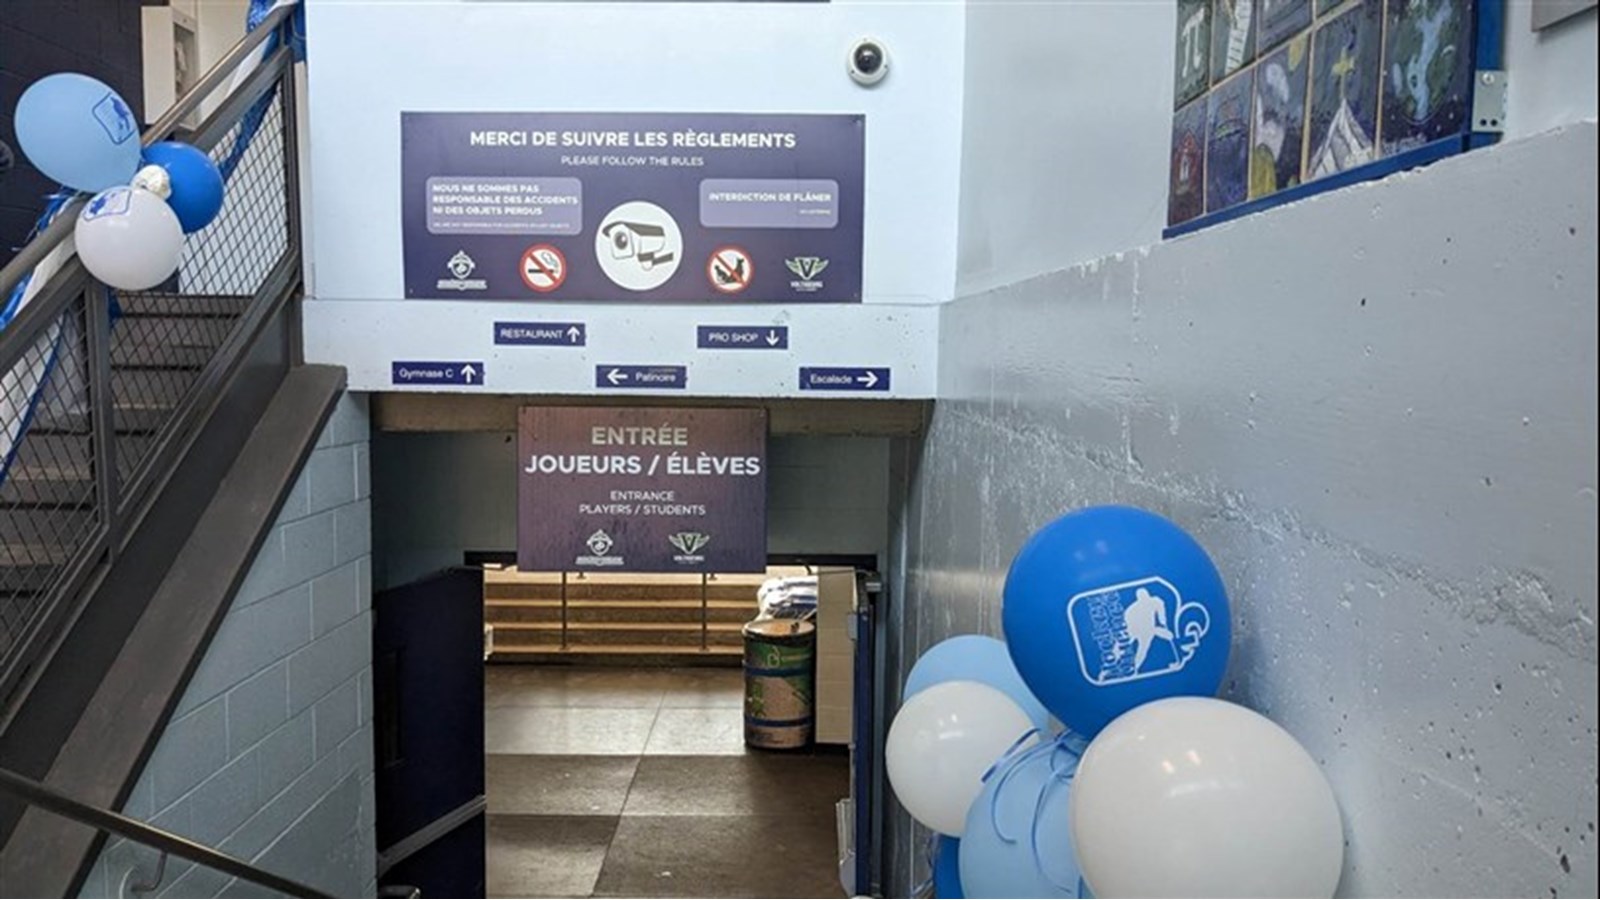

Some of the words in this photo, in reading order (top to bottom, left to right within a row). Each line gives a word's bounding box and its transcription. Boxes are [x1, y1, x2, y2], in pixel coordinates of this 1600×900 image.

[470, 131, 527, 146] MERCI
[532, 131, 557, 146] DE
[562, 131, 629, 147] SUIVRE
[634, 132, 668, 147] LES
[673, 128, 796, 148] RÈGLEMENTS
[561, 156, 599, 165] PLEASE
[602, 156, 646, 166] FOLLOW
[650, 157, 668, 166] THE
[671, 157, 704, 166] RULES
[432, 184, 460, 193] NOUS
[462, 184, 475, 193] NE
[477, 184, 518, 193] SOMMES
[520, 185, 539, 193] PAS
[432, 195, 501, 204] RESPONSABLE
[503, 195, 522, 204] DES
[524, 196, 578, 204] ACCIDENTS
[709, 192, 777, 202] INTERDICTION
[779, 192, 791, 201] DE
[793, 190, 832, 202] FLÂNER
[432, 206, 443, 215] NI
[445, 206, 464, 215] DES
[466, 206, 501, 215] OBJETS
[504, 207, 543, 215] PERDUS
[500, 328, 564, 339] RESTAURANT
[708, 332, 730, 343] PRO
[731, 333, 758, 343] SHOP
[399, 369, 444, 380] Gymnase
[446, 369, 454, 378] C
[635, 371, 677, 383] Patinoire
[810, 374, 853, 384] Escalade
[591, 422, 688, 446] ENTRÉE
[524, 455, 642, 474] JOUEURS
[647, 454, 660, 476] /
[667, 451, 761, 475] ÉLÈVES
[610, 490, 675, 501] ENTRANCE
[579, 504, 632, 515] PLAYERS
[643, 505, 706, 516] STUDENTS
